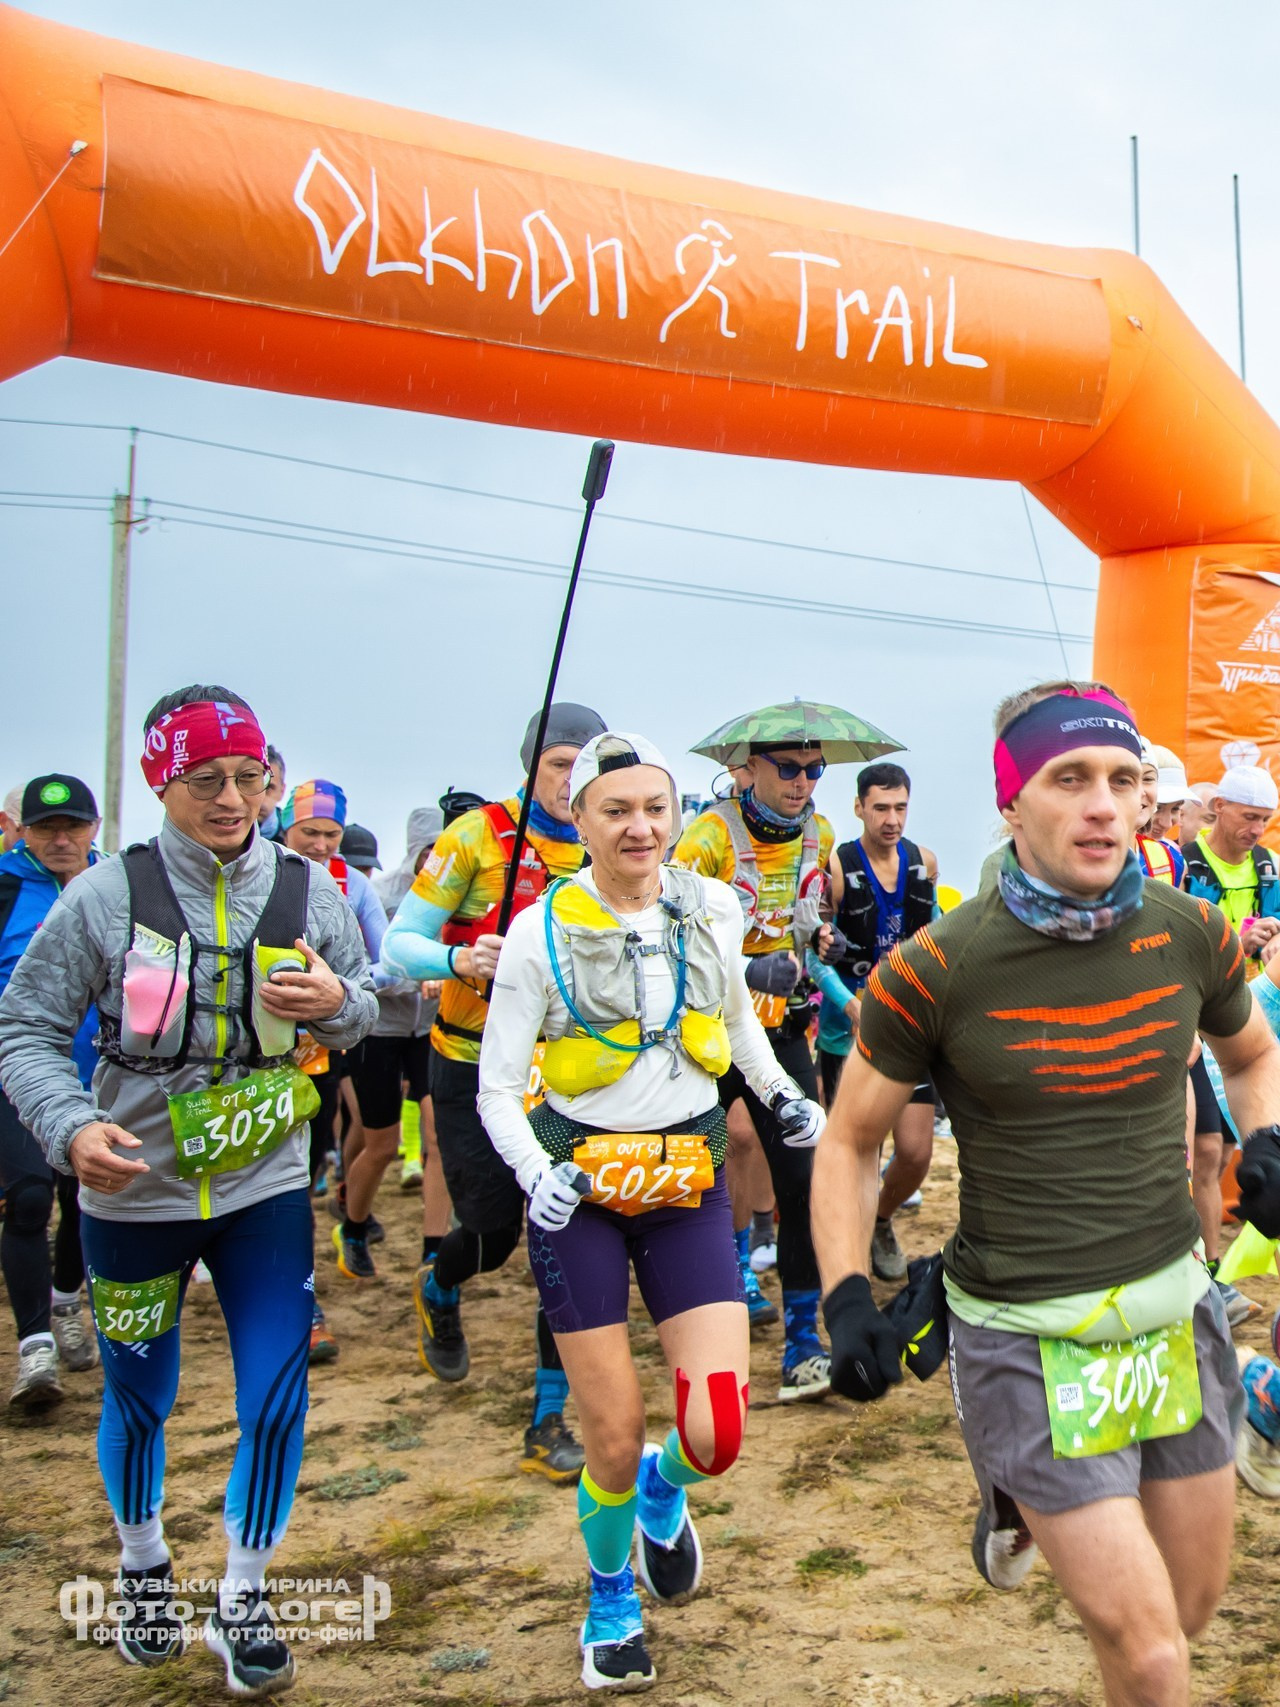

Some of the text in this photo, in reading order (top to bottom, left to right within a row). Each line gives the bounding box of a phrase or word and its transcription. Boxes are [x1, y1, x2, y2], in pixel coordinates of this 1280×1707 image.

[221, 1084, 257, 1107] OT 30
[204, 1086, 294, 1161] 3039
[617, 1140, 646, 1159] OUT
[647, 1142, 662, 1158] 50
[595, 1160, 697, 1204] 5023
[114, 1289, 129, 1300] OT
[130, 1288, 142, 1299] 30
[104, 1299, 167, 1336] 3039
[1080, 1341, 1171, 1429] 3005
